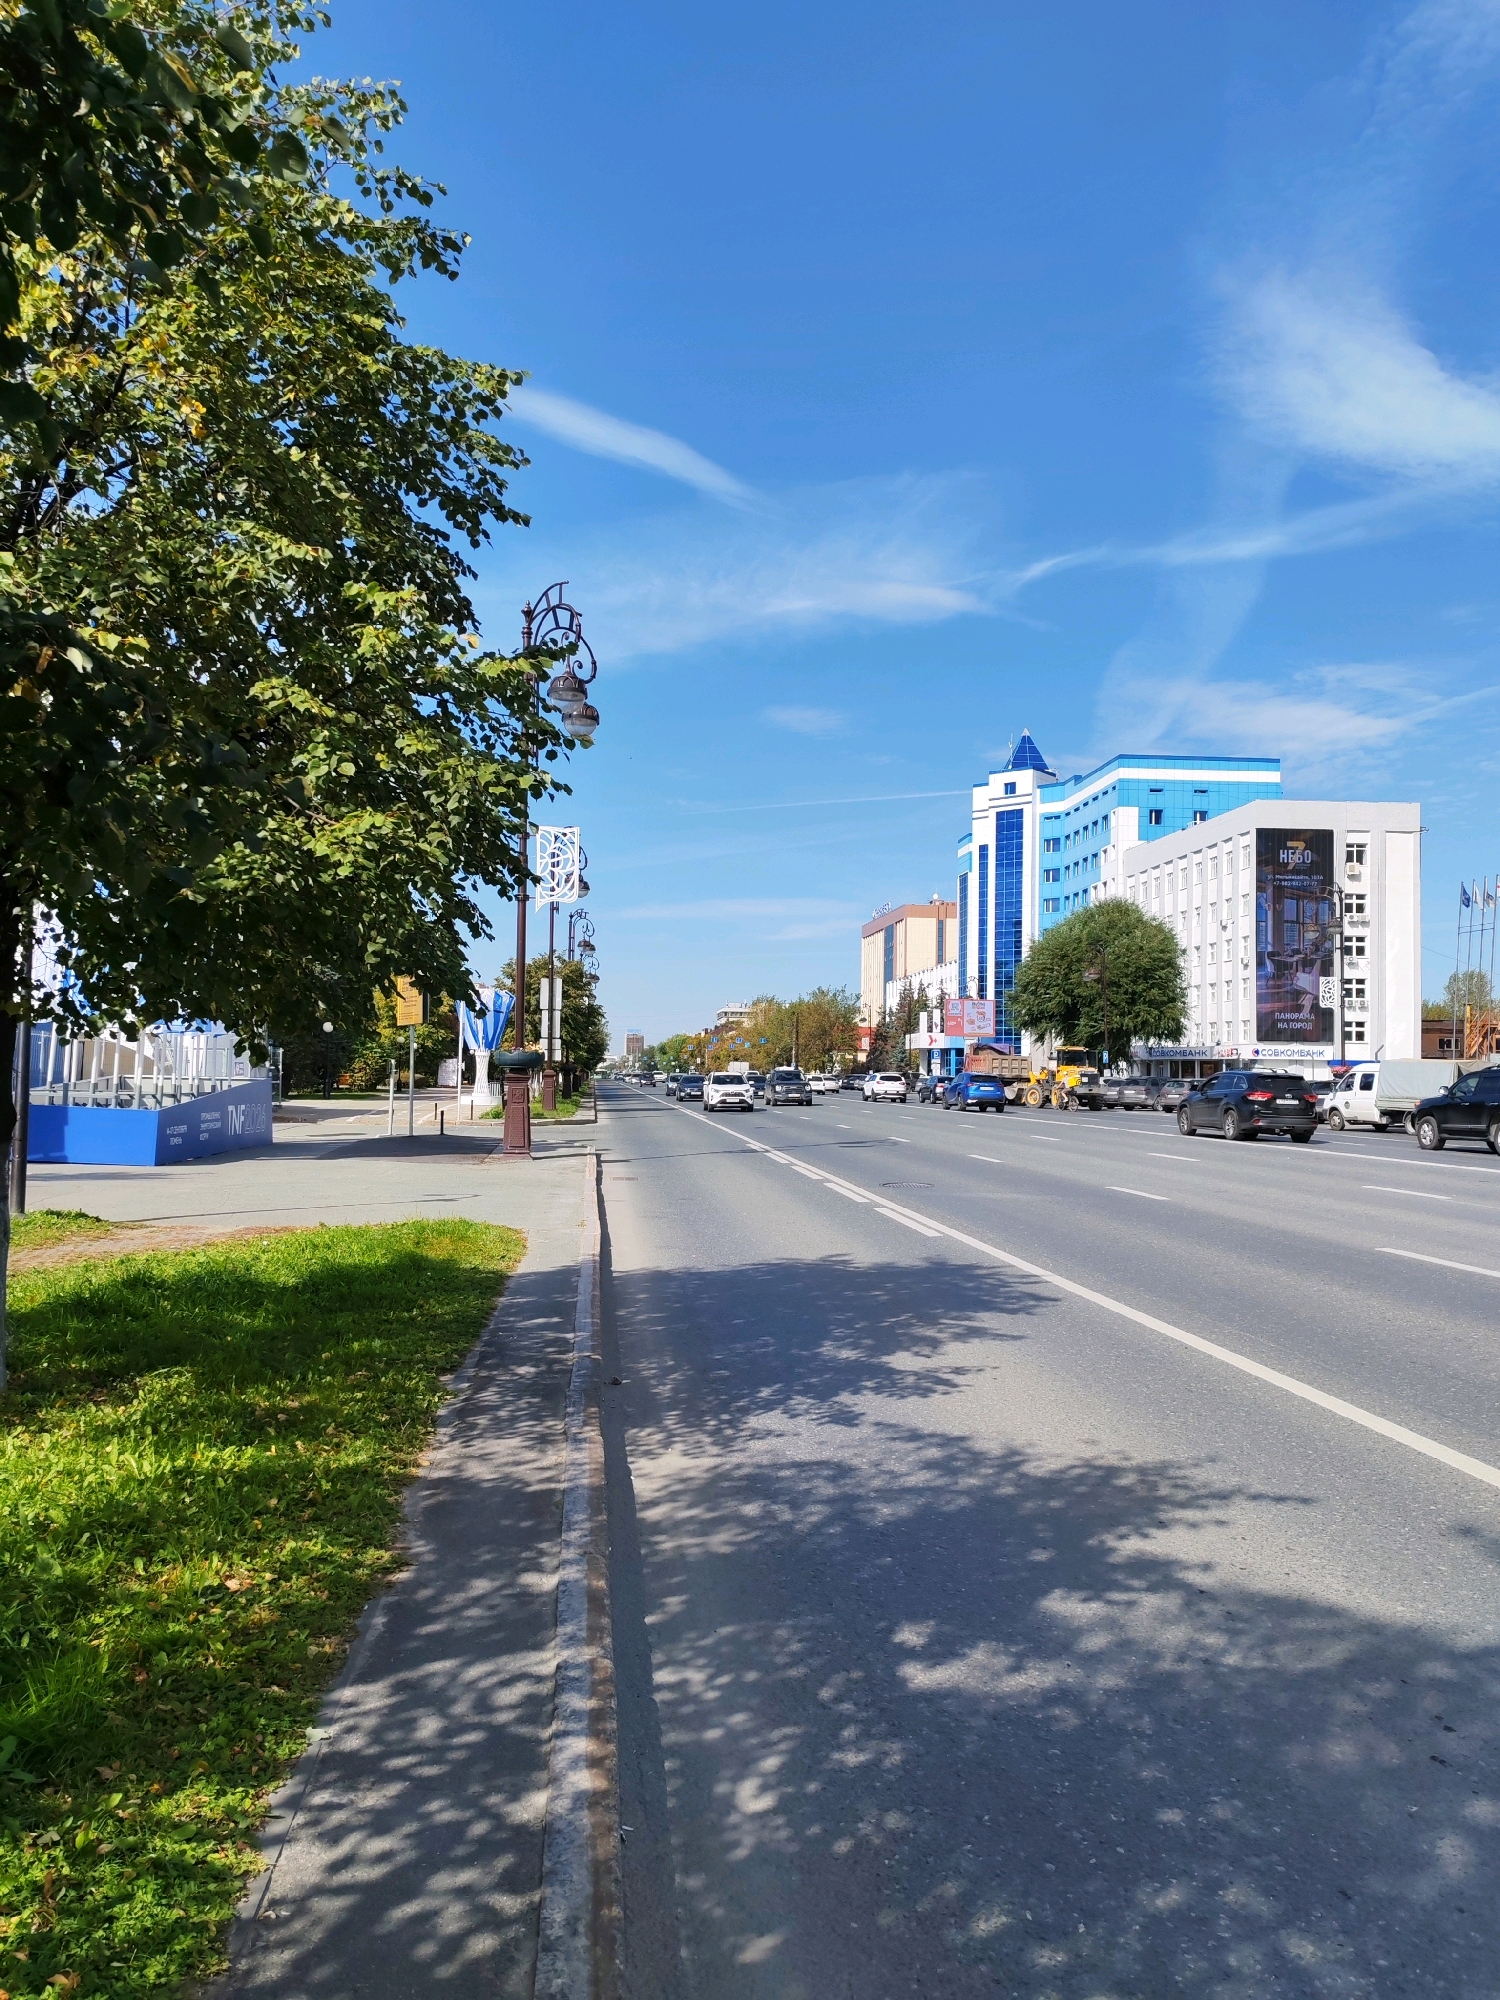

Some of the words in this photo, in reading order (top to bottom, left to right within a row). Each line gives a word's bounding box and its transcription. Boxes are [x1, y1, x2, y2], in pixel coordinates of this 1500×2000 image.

[1280, 850, 1312, 863] НЕБО
[1261, 1049, 1325, 1057] СОВКОМБАНК
[228, 1105, 245, 1136] TNF
